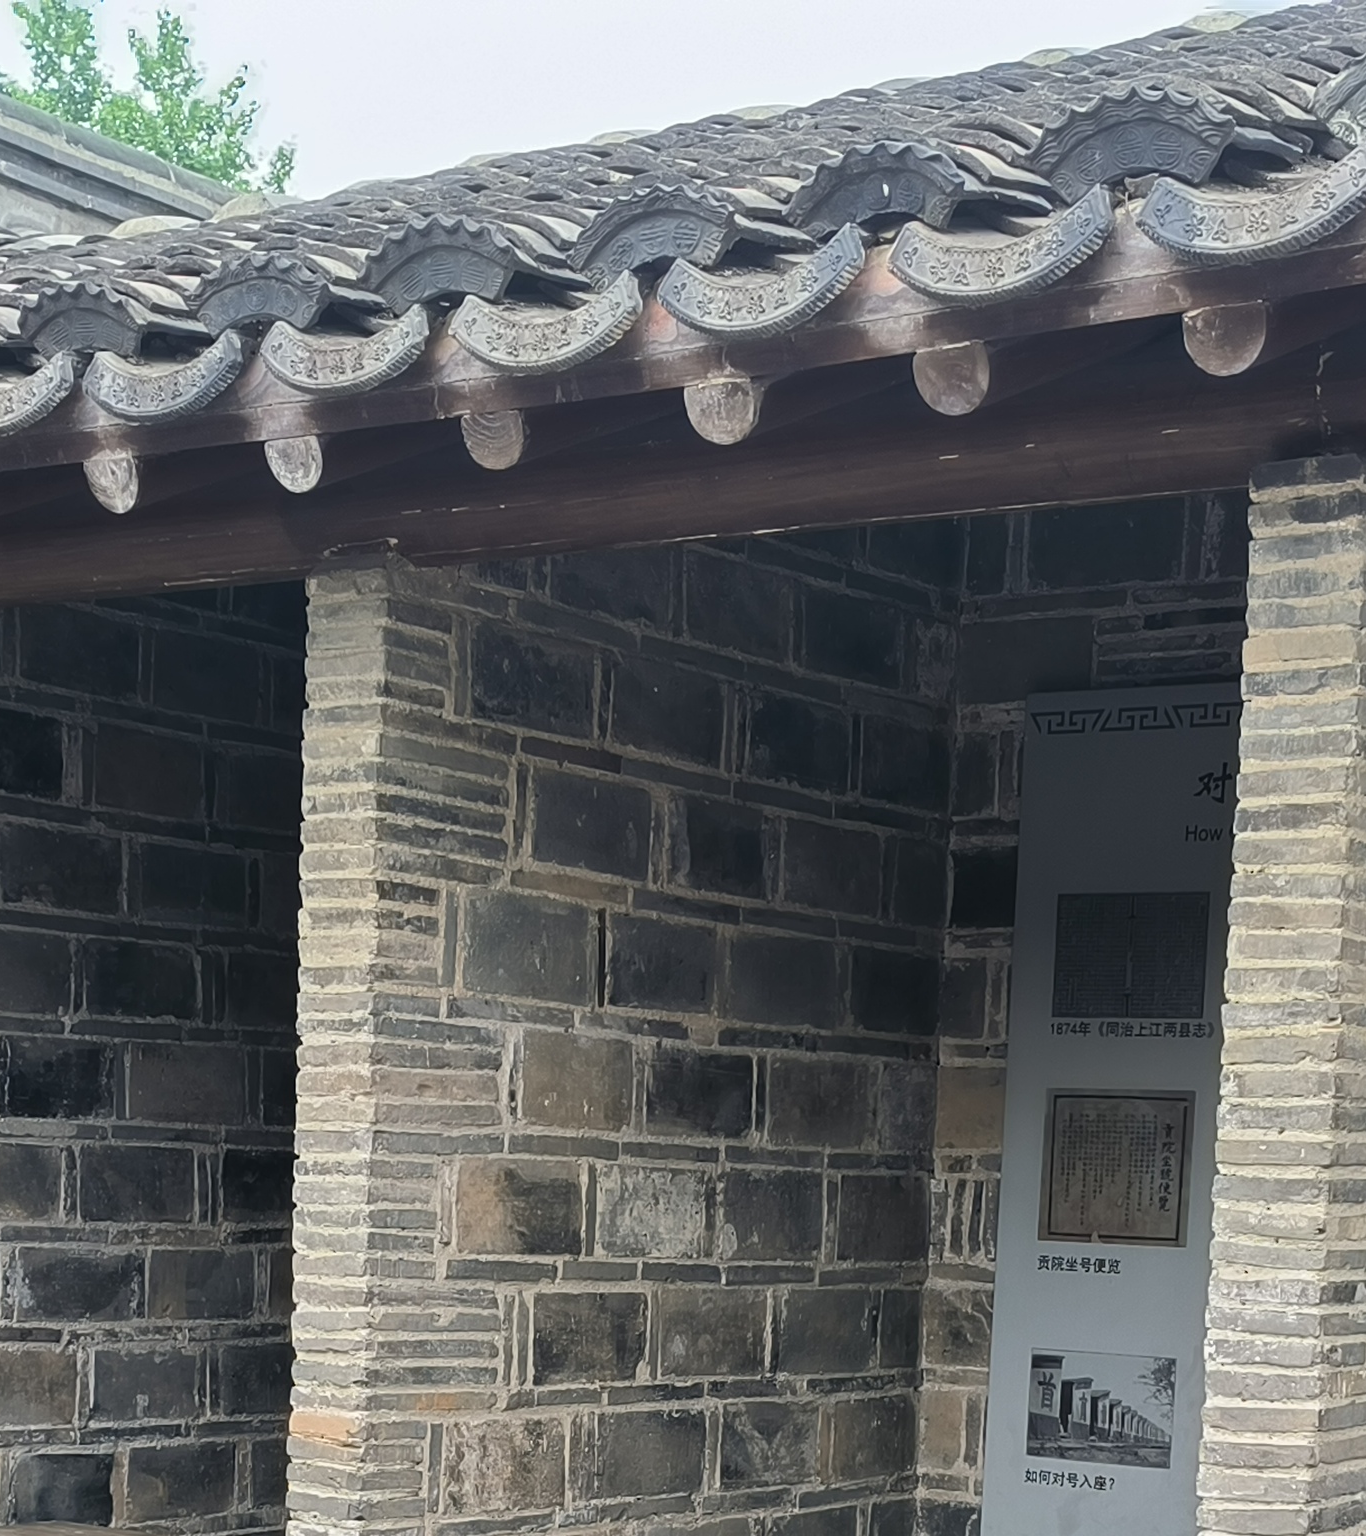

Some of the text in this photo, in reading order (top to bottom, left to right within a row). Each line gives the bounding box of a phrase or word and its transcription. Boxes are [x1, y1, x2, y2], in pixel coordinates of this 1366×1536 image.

[1193, 762, 1233, 804] 对
[1185, 825, 1223, 842] How
[1050, 1021, 1216, 1038] 1874年《同治上江两县志》
[1037, 1254, 1121, 1275] 贡院坐号便览
[1037, 1371, 1057, 1412] 首
